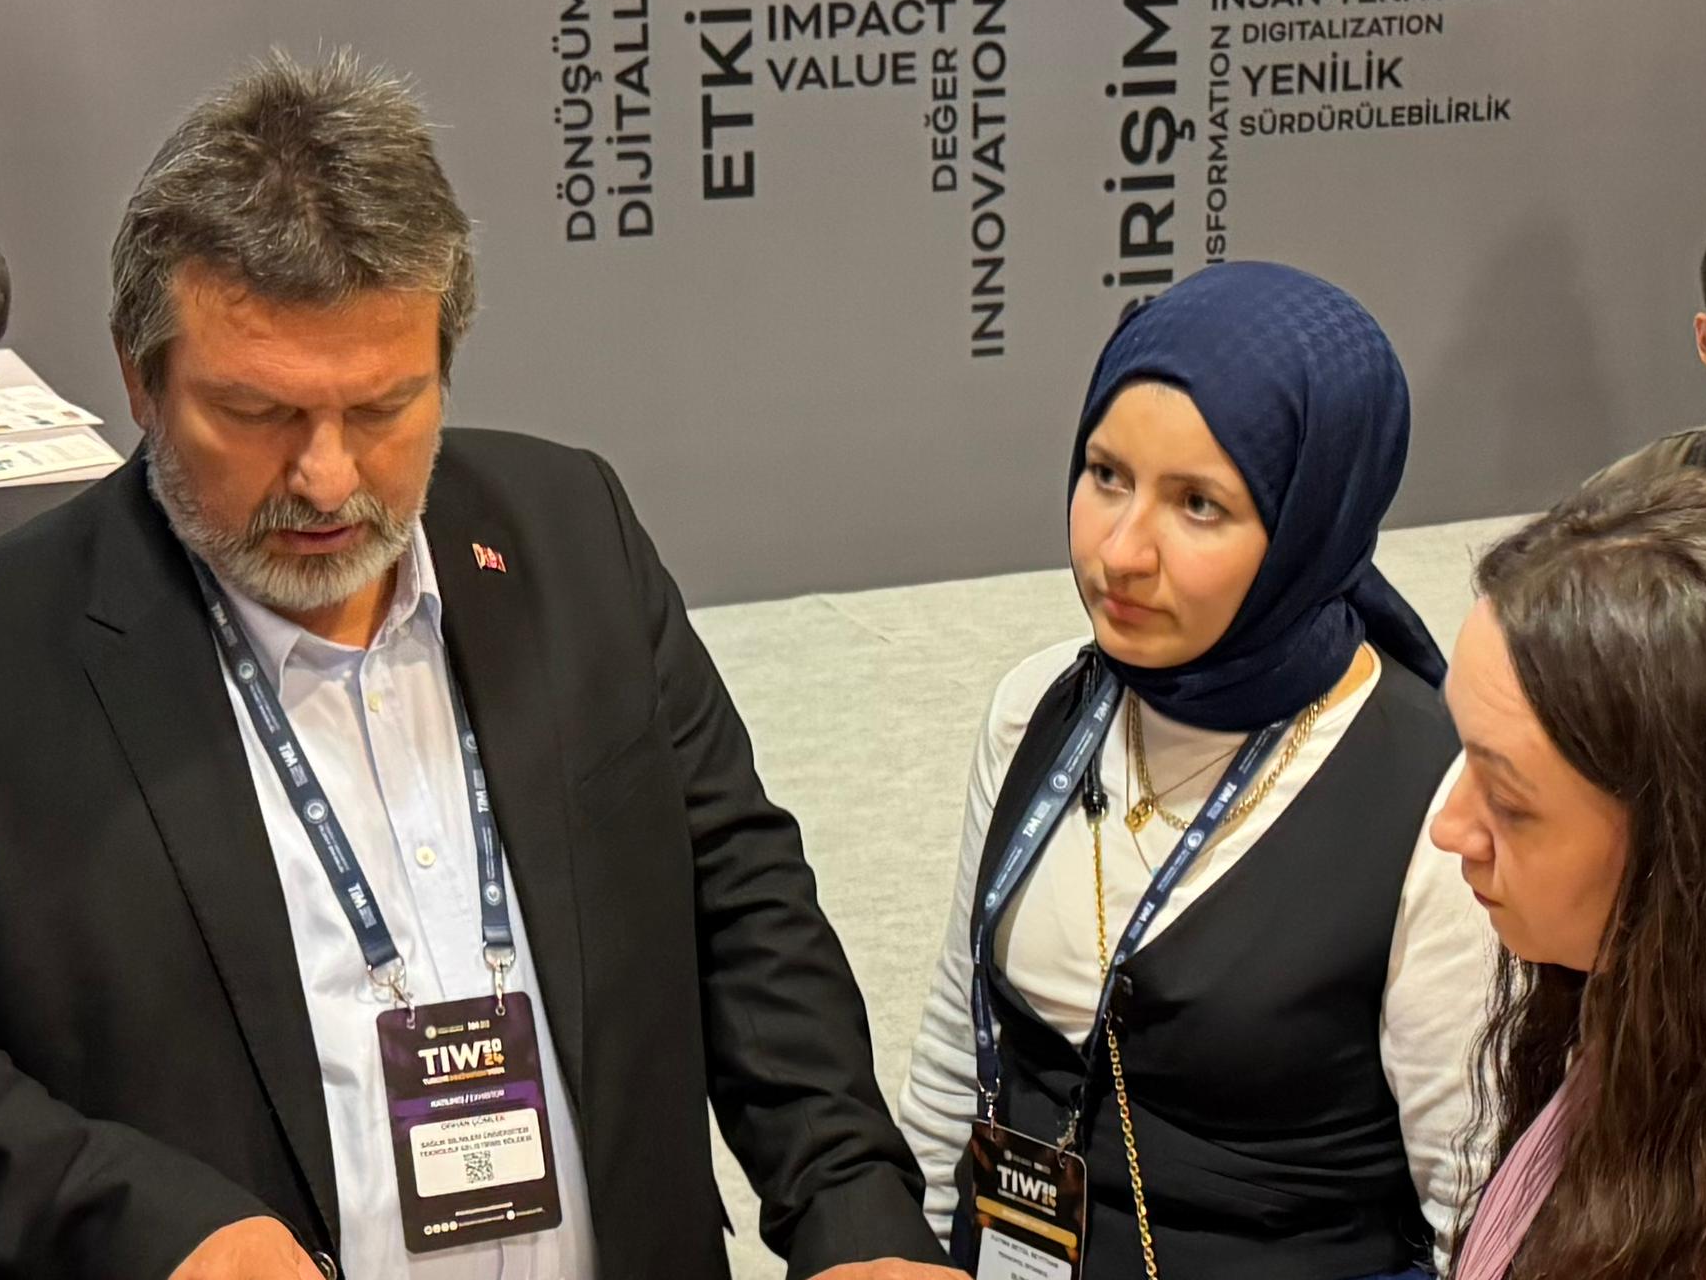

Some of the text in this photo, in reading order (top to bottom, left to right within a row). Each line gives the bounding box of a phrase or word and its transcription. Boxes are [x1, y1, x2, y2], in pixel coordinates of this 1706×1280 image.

[1241, 14, 1444, 45] DIGITALIZATION
[767, 51, 917, 92] VALUE
[1241, 50, 1404, 97] YENİLİK
[686, 7, 756, 200] ETKİ
[924, 47, 959, 192] DEĞER
[1240, 98, 1512, 138] SÜRDÜRÜLEBİLİRLİK
[418, 1041, 481, 1075] TIW
[997, 1165, 1043, 1201] TIW
